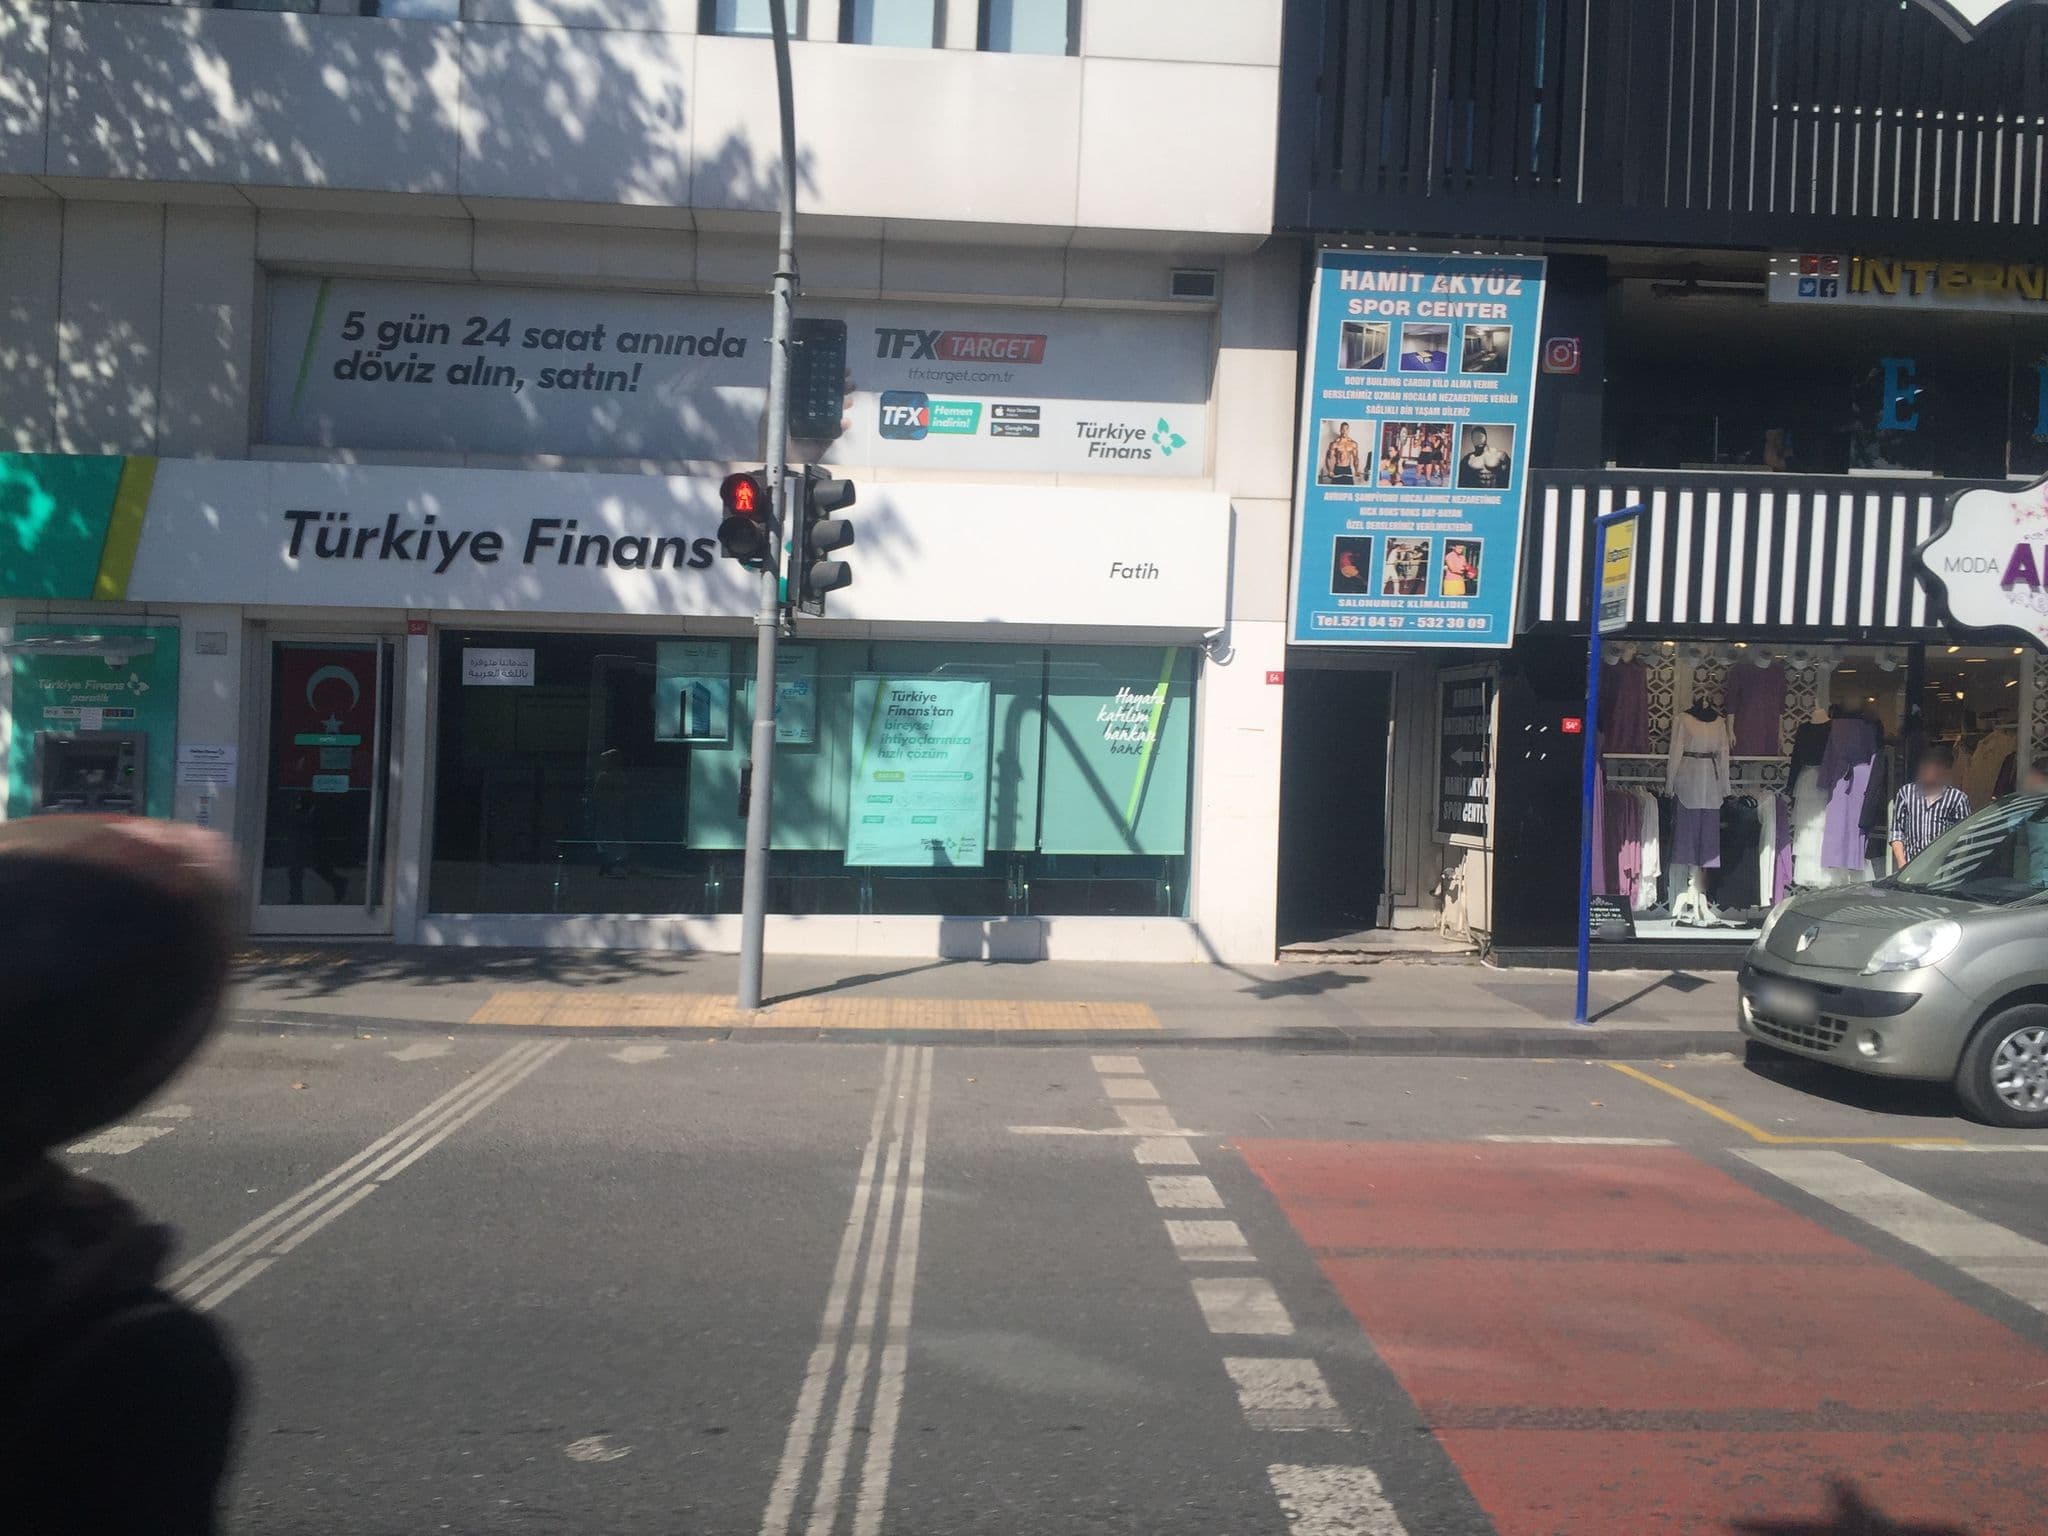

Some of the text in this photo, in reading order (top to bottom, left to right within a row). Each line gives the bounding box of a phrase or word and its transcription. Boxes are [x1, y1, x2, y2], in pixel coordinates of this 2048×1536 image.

[1339, 265, 1522, 296] HAMİT AKYÜZ
[1349, 299, 1507, 319] SPOR CENTER
[341, 310, 748, 359] 5 gün 24 saat anında
[874, 328, 1037, 361] TFX TARGET
[333, 350, 643, 394] döviz alın, satın!
[908, 367, 1015, 385] tfxtarget.com.tr
[882, 406, 919, 426] TFX
[934, 405, 973, 416] Hemen
[932, 417, 971, 428] indirin!
[1076, 422, 1147, 445] Türkiye
[1088, 442, 1152, 461] Finans
[284, 510, 717, 575] Türkiye Finans
[1109, 561, 1160, 580] Fatih
[1944, 556, 2000, 574] MODA
[1338, 598, 1404, 608] SALONUMUZ
[1417, 617, 1444, 628] 532
[84, 679, 125, 690] Finans
[891, 690, 938, 705] Türkiye
[887, 705, 954, 717] Finans'tan
[884, 720, 935, 732] bireysel
[877, 748, 949, 761] hızlı çözüm
